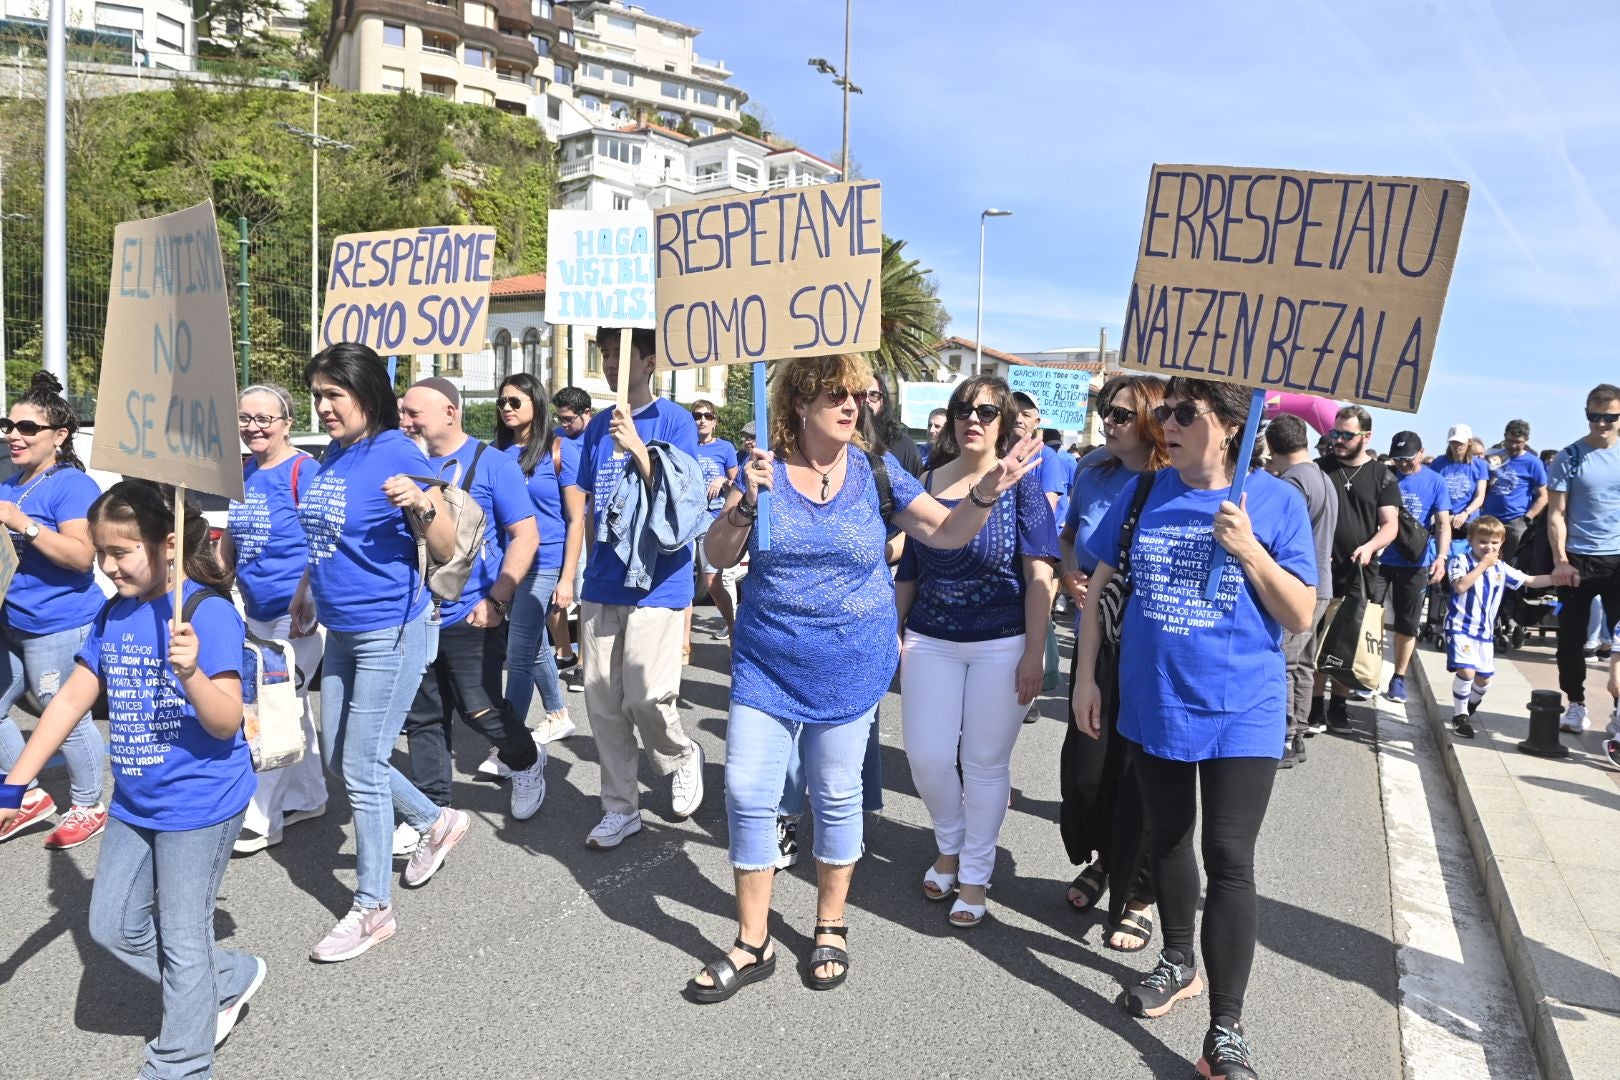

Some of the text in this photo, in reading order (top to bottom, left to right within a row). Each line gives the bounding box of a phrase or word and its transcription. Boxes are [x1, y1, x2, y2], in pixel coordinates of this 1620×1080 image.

[656, 183, 880, 278] RESPÉTAME
[1145, 171, 1448, 278] ERRESPETATU
[575, 227, 654, 256] HAGA
[330, 228, 496, 290] RESPETAME
[120, 237, 150, 299] EL
[558, 287, 654, 320] INVIS
[324, 295, 485, 349] COMO SOY
[664, 279, 872, 367] COMO SOY
[154, 313, 192, 374] NO
[1121, 283, 1422, 409] NAIZEN BEZALA
[1014, 370, 1043, 378] GRACIAS
[1054, 390, 1088, 402] AUTISMO
[119, 390, 224, 459] SE CURA
[1188, 526, 1214, 534] MUCH
[1139, 535, 1212, 552] URDIN ANITZ UN
[1185, 533, 1212, 542] URDIN
[1135, 545, 1210, 560] MUCHOS MATICES
[1145, 554, 1172, 564] URDIN
[1175, 560, 1202, 570] ANITZ
[1169, 567, 1208, 580] MATICES
[1222, 575, 1244, 584] RDIN
[1145, 573, 1170, 584] URDIN
[1173, 578, 1200, 588] ANITZ
[1219, 584, 1242, 594] AZUL
[1168, 586, 1204, 598] MATICES
[1136, 589, 1232, 612] BAT URDIN ANITZ UN
[1157, 603, 1189, 616] MUCHOS
[1191, 609, 1222, 620] MATICES
[1144, 610, 1214, 628] URDIN BAT URDIN
[1162, 624, 1190, 636] ANITZ
[122, 633, 134, 642] UN
[102, 643, 152, 655] AZUL MUCHOS
[121, 655, 140, 666] URDIN
[144, 657, 163, 668] BAT
[109, 666, 128, 676] ANITZ
[130, 668, 142, 676] UN
[112, 678, 142, 688] MATICES
[114, 689, 136, 698] ANITZ
[137, 689, 154, 698] UN
[157, 687, 178, 698] AZU
[112, 698, 186, 711] MATICES URDIN
[116, 712, 138, 722] ANITZ
[140, 712, 154, 722] UN
[158, 709, 186, 721] AZUL
[114, 720, 182, 734] MATICES URDIN
[129, 733, 158, 744] ANITZ
[164, 731, 178, 741] UN
[112, 742, 170, 756] MUCHOS MATICES
[122, 756, 134, 766] BAT
[136, 755, 164, 766] URDIN
[122, 767, 142, 776] ANITZ
